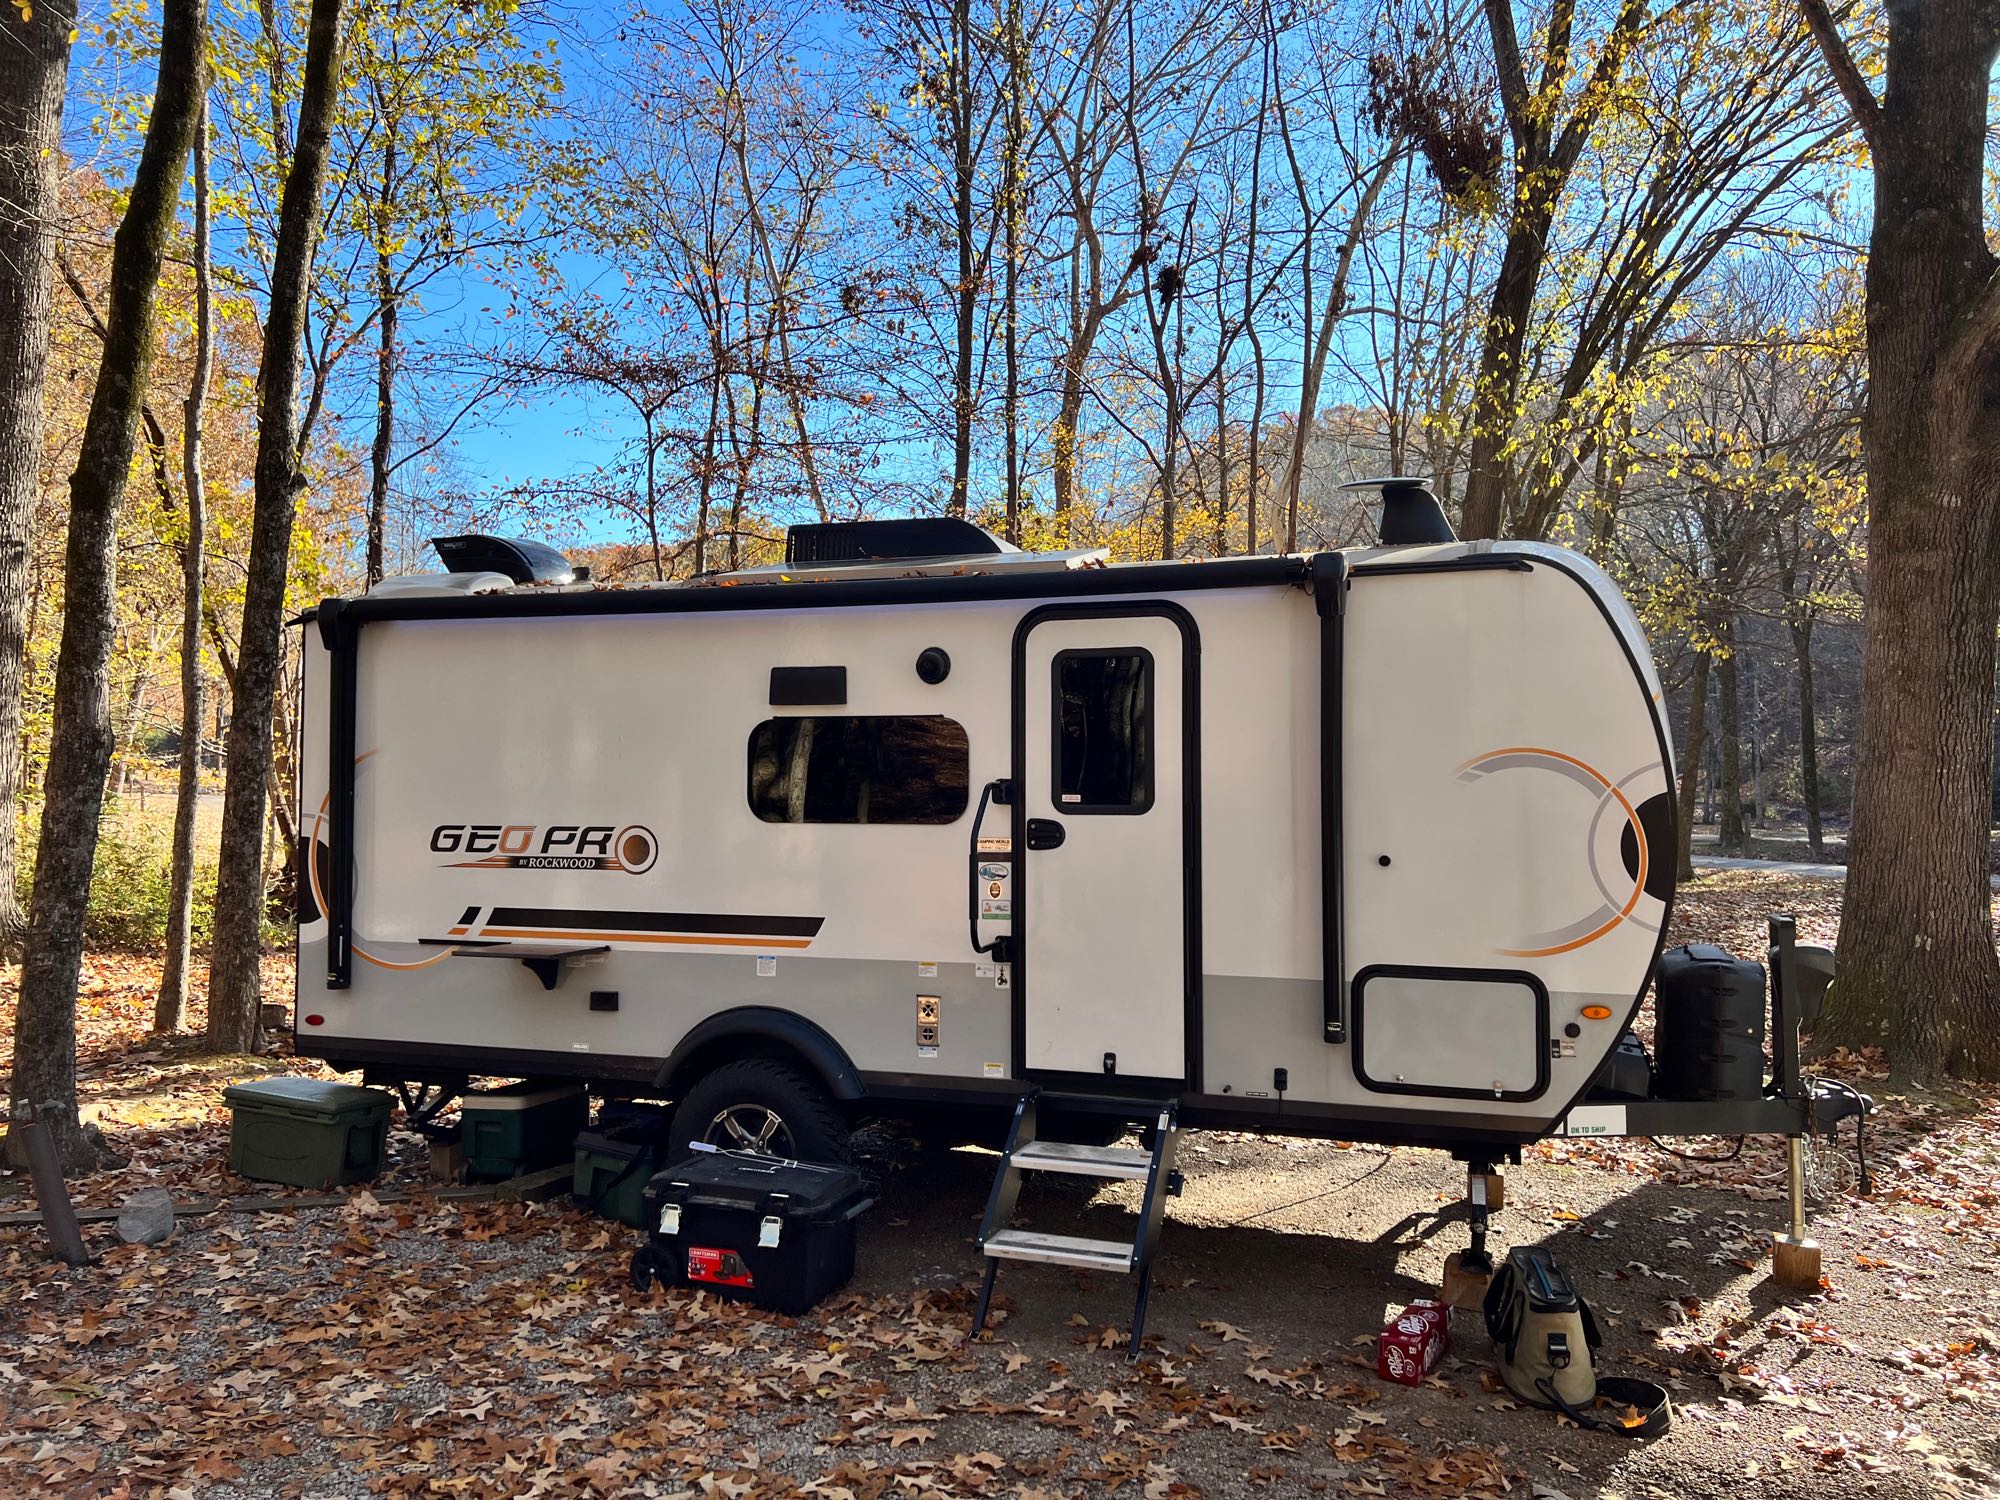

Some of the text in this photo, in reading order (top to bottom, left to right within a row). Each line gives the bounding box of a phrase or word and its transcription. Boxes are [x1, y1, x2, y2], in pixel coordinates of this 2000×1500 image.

[430, 824, 659, 876] GEO PRO
[529, 858, 596, 869] ROCKWOOD
